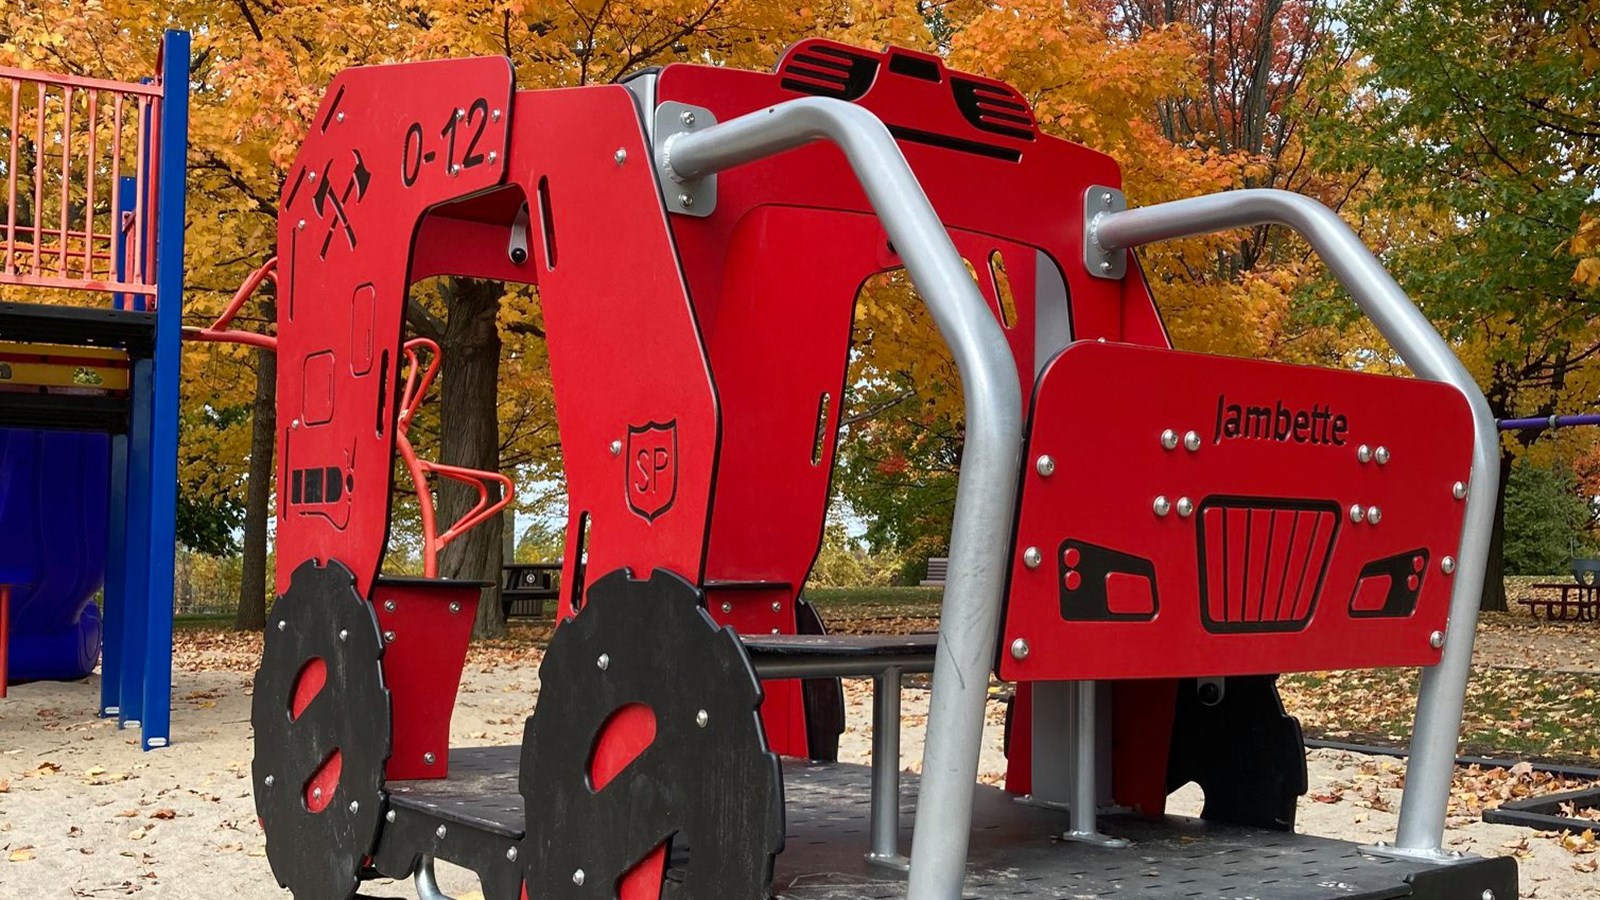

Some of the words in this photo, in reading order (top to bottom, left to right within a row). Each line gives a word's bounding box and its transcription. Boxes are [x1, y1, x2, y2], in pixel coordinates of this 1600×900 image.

[402, 97, 488, 188] 0-12
[1213, 394, 1349, 446] Jambette
[635, 447, 669, 494] SP
